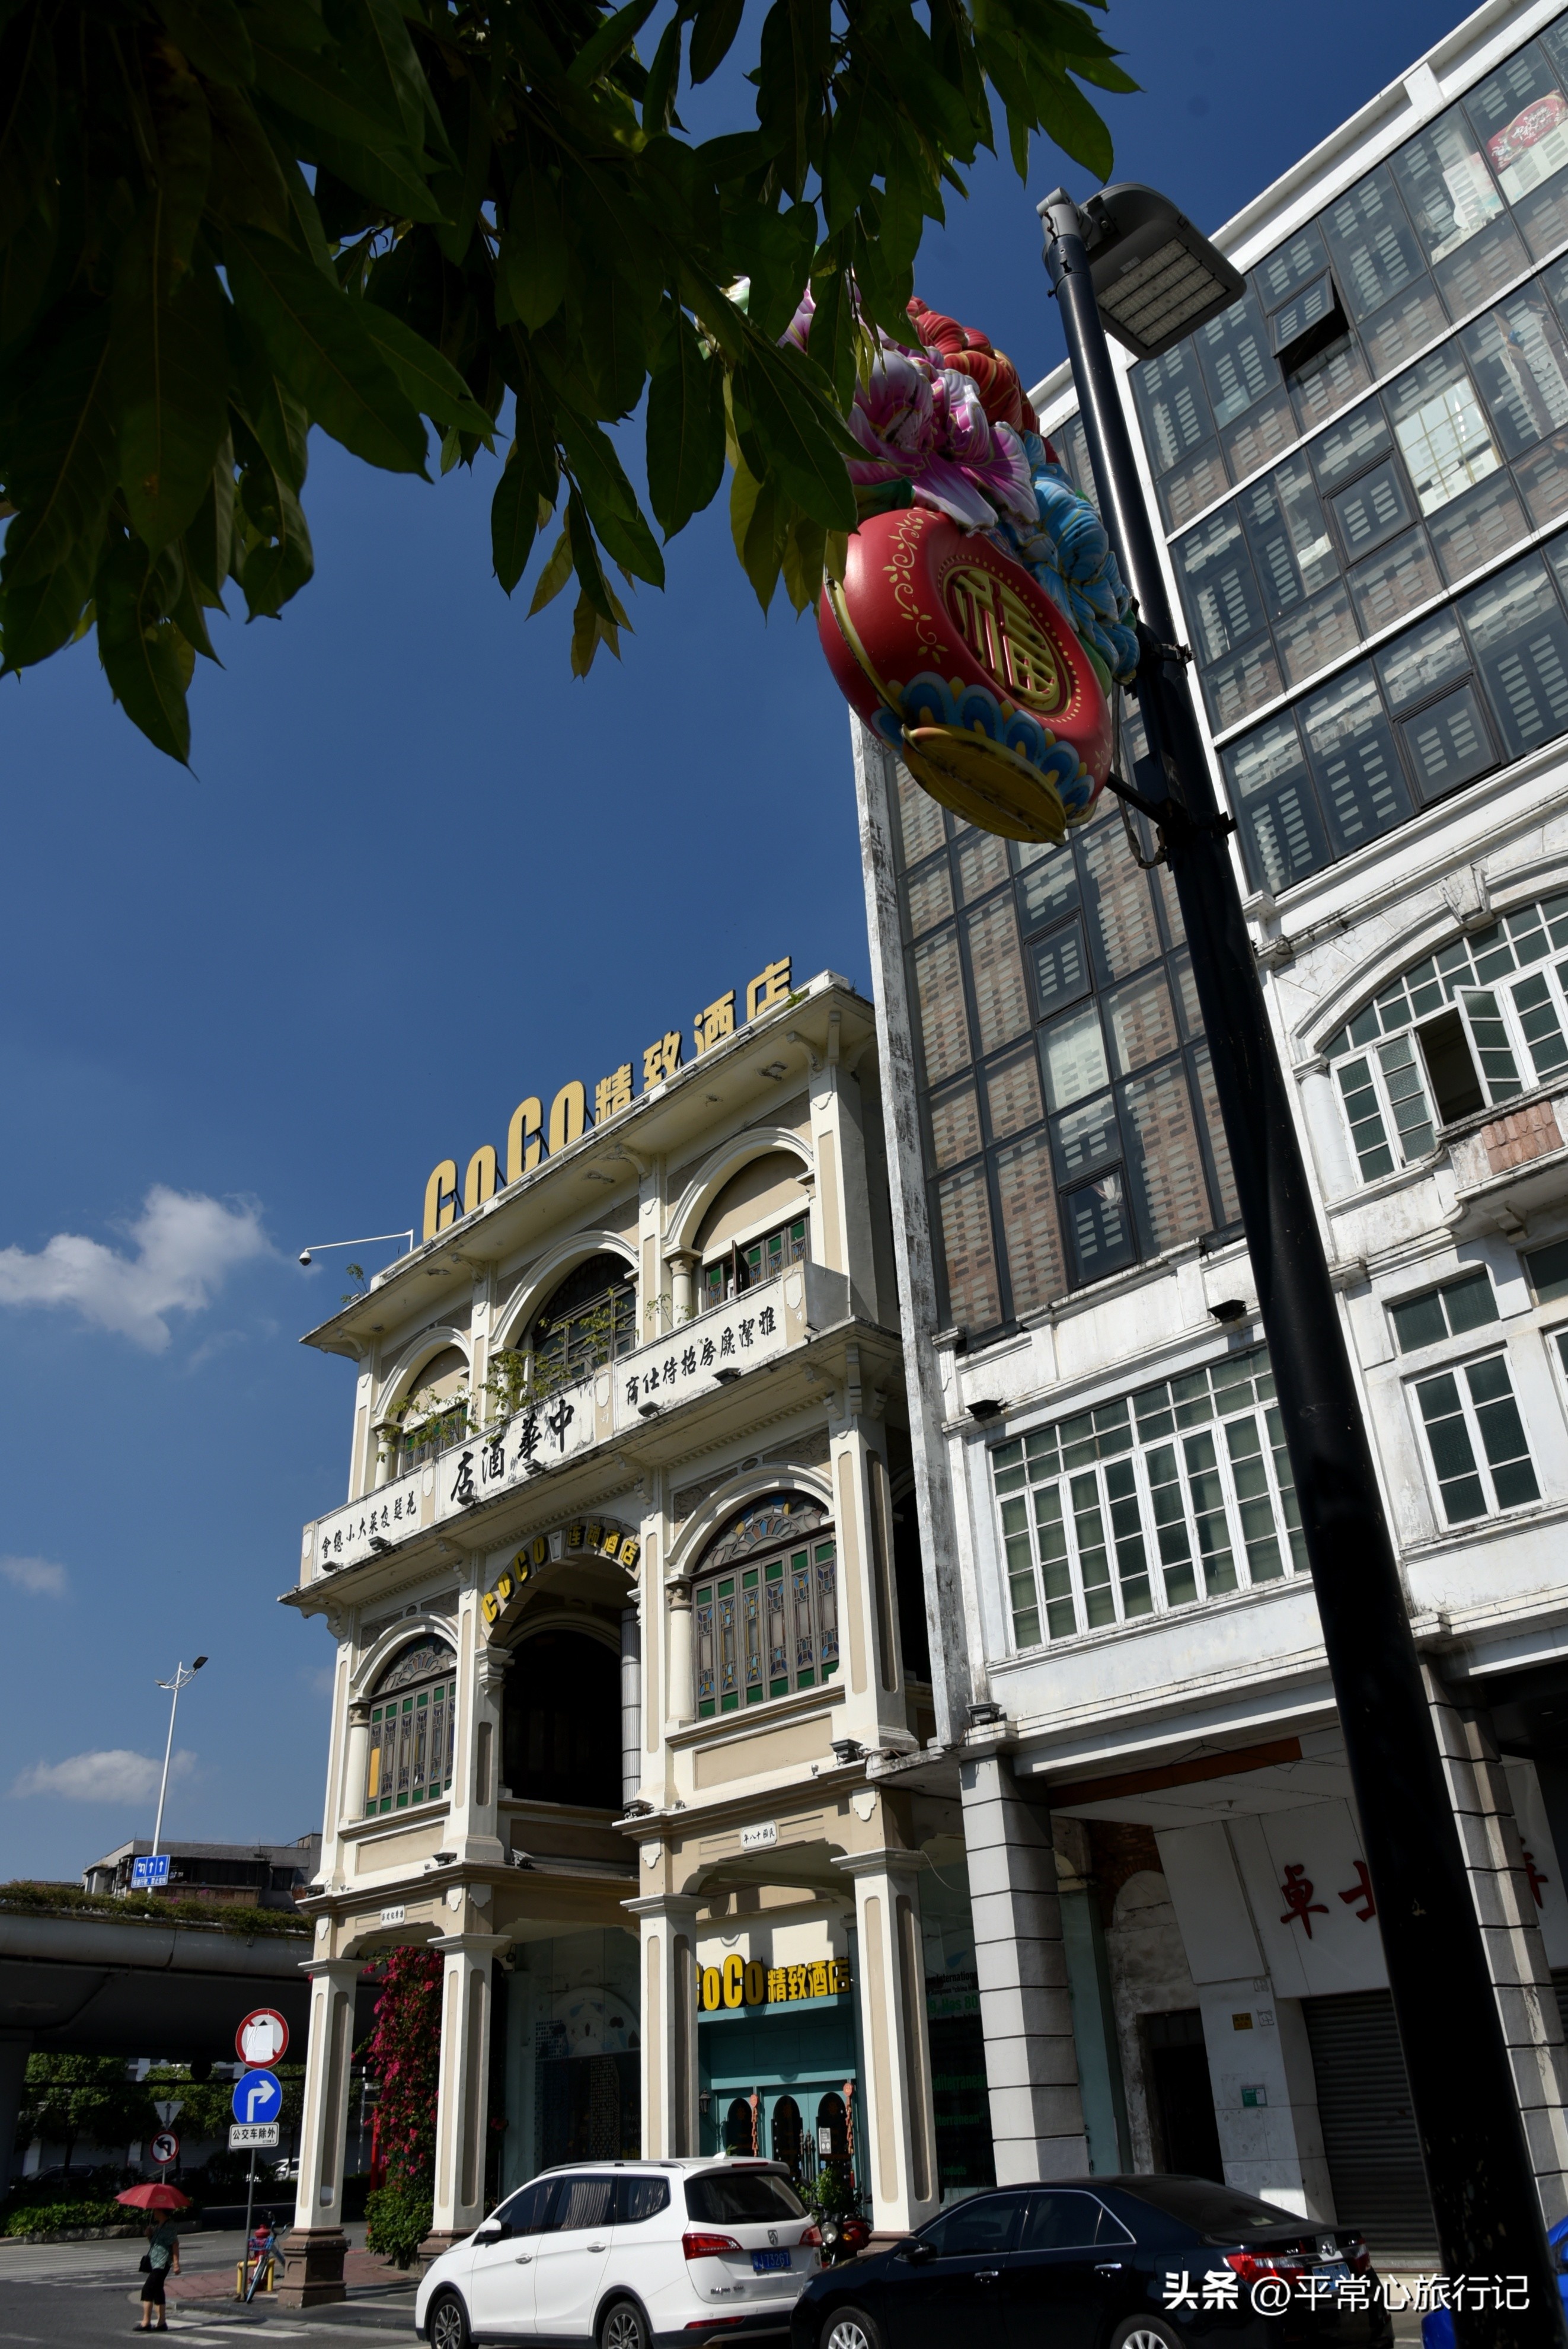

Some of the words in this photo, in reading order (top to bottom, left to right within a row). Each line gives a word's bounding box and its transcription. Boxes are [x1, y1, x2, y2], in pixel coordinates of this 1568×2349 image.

[949, 570, 1058, 701] 福
[567, 1524, 639, 1566] 连锁酒店
[233, 2127, 275, 2140] 公交车除外
